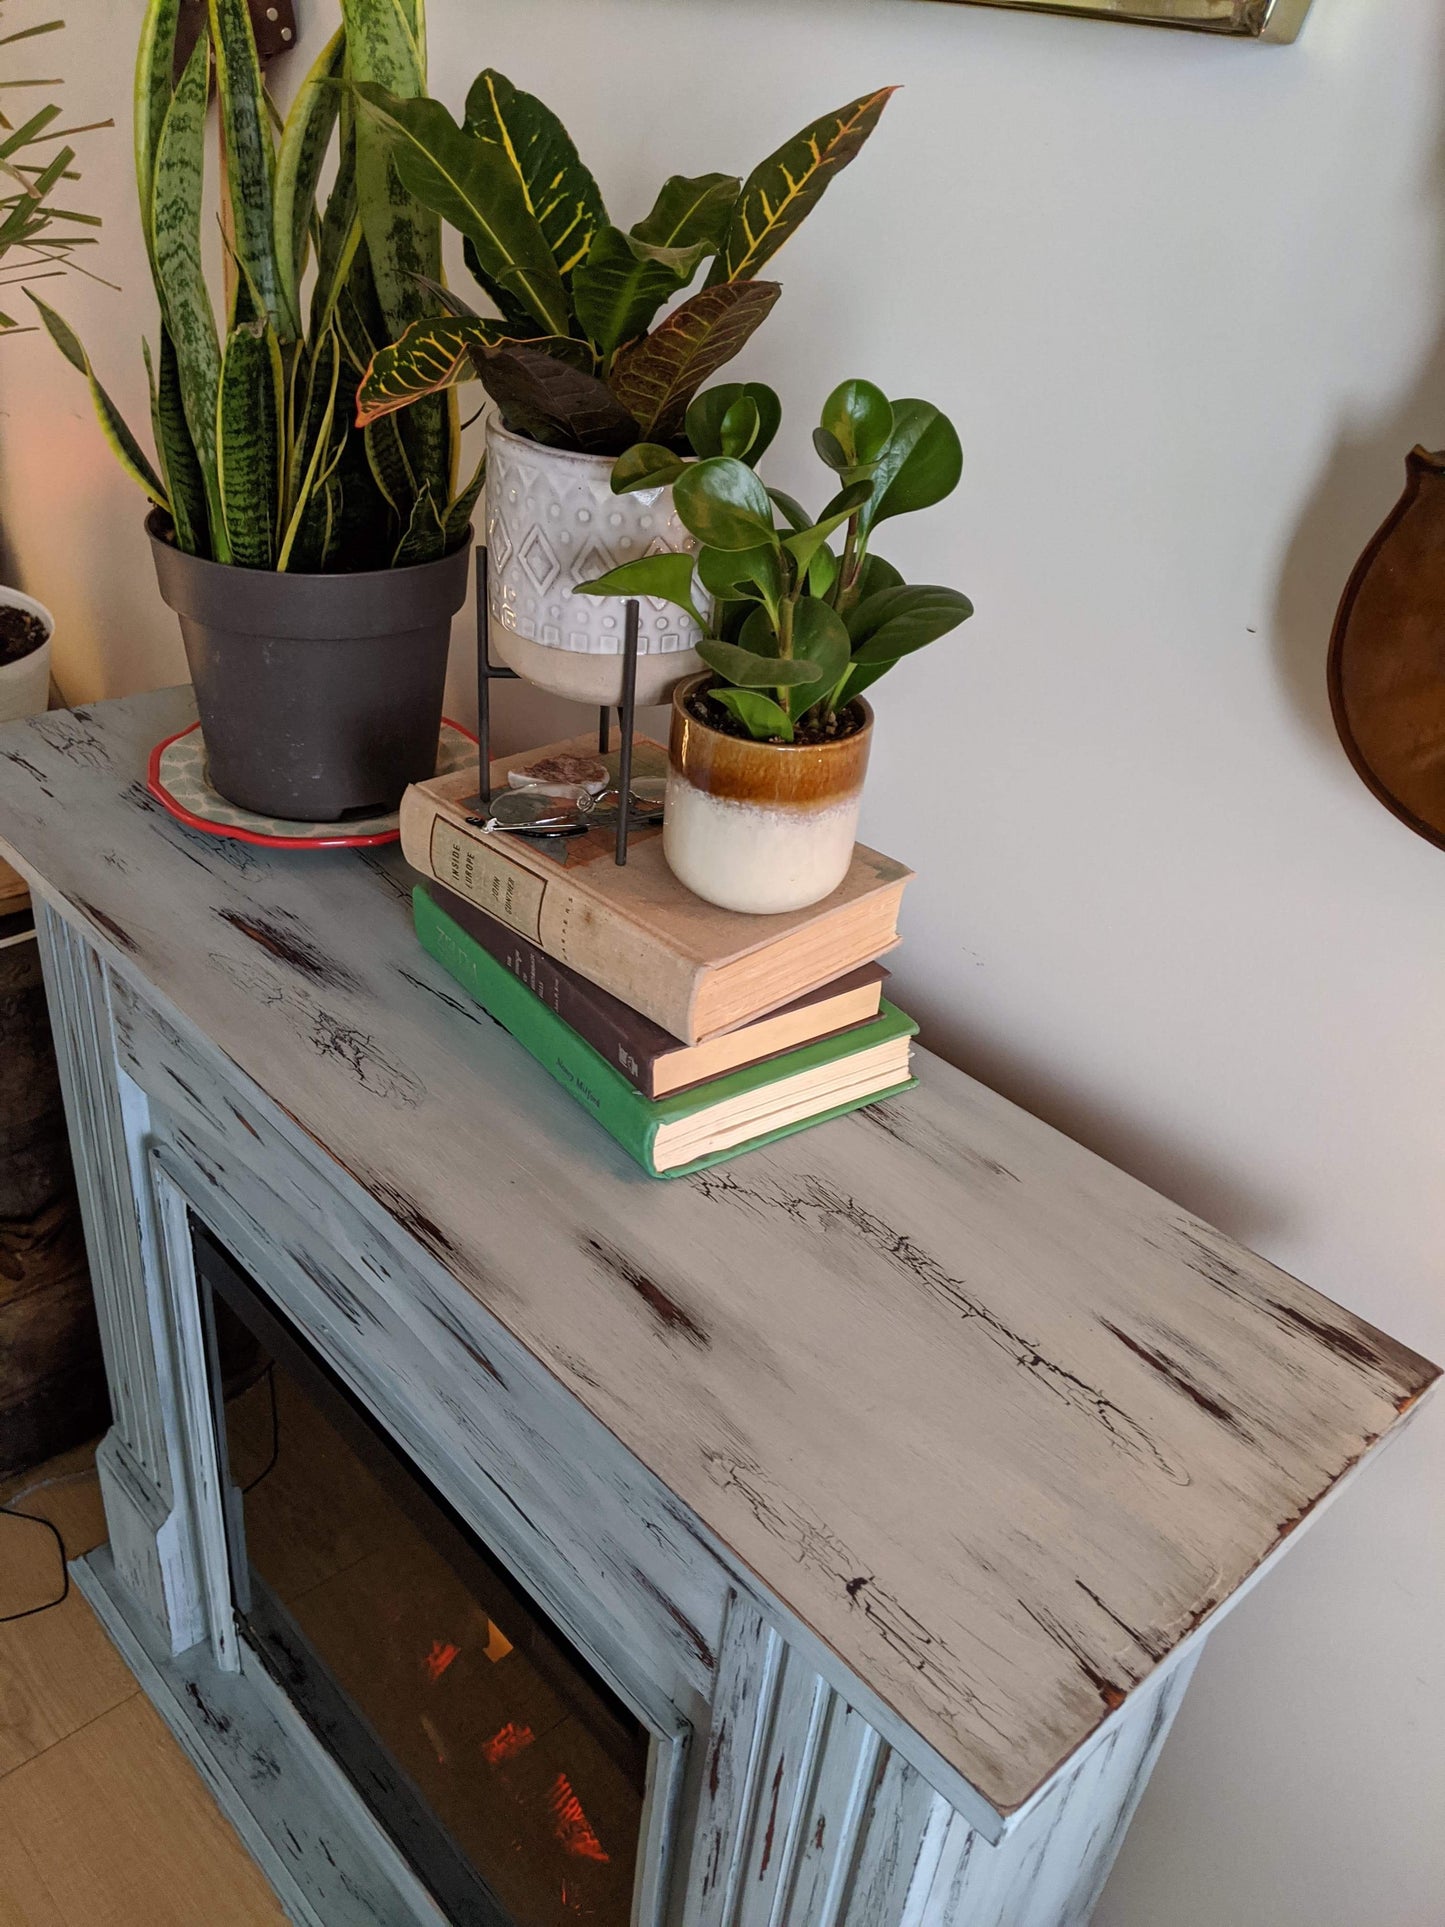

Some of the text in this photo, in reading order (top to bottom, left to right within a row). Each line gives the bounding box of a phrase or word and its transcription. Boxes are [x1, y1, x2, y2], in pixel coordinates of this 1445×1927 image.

[451, 843, 461, 881] INSIDE
[465, 852, 475, 889] EUROPE
[492, 875, 501, 901] JOHN
[504, 877, 515, 915] GUNTHER
